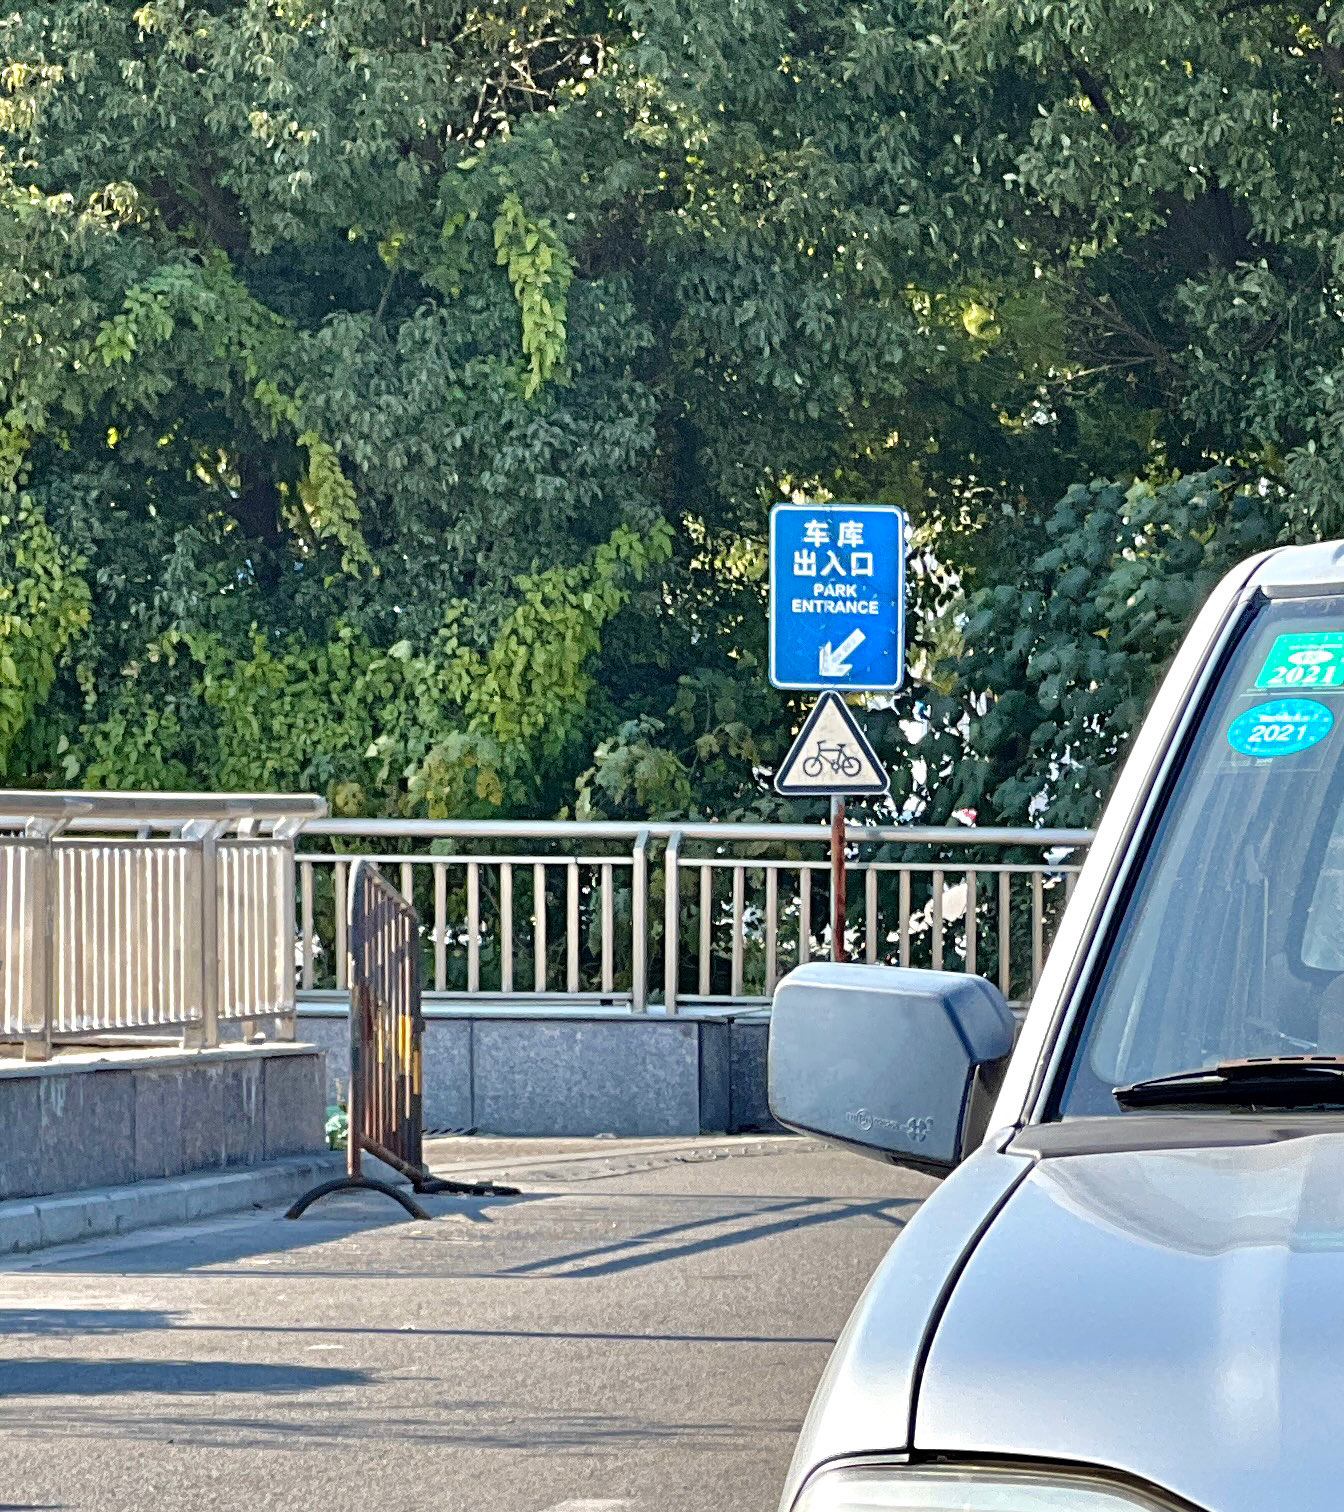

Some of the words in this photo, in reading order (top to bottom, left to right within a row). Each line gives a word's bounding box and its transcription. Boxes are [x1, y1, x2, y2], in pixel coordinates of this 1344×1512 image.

[804, 519, 864, 548] 车库
[793, 549, 873, 577] 出入口
[813, 583, 857, 597] PARK
[791, 599, 879, 614] ENTRANCE
[1267, 666, 1337, 684] 2021
[1248, 724, 1307, 742] 2021
